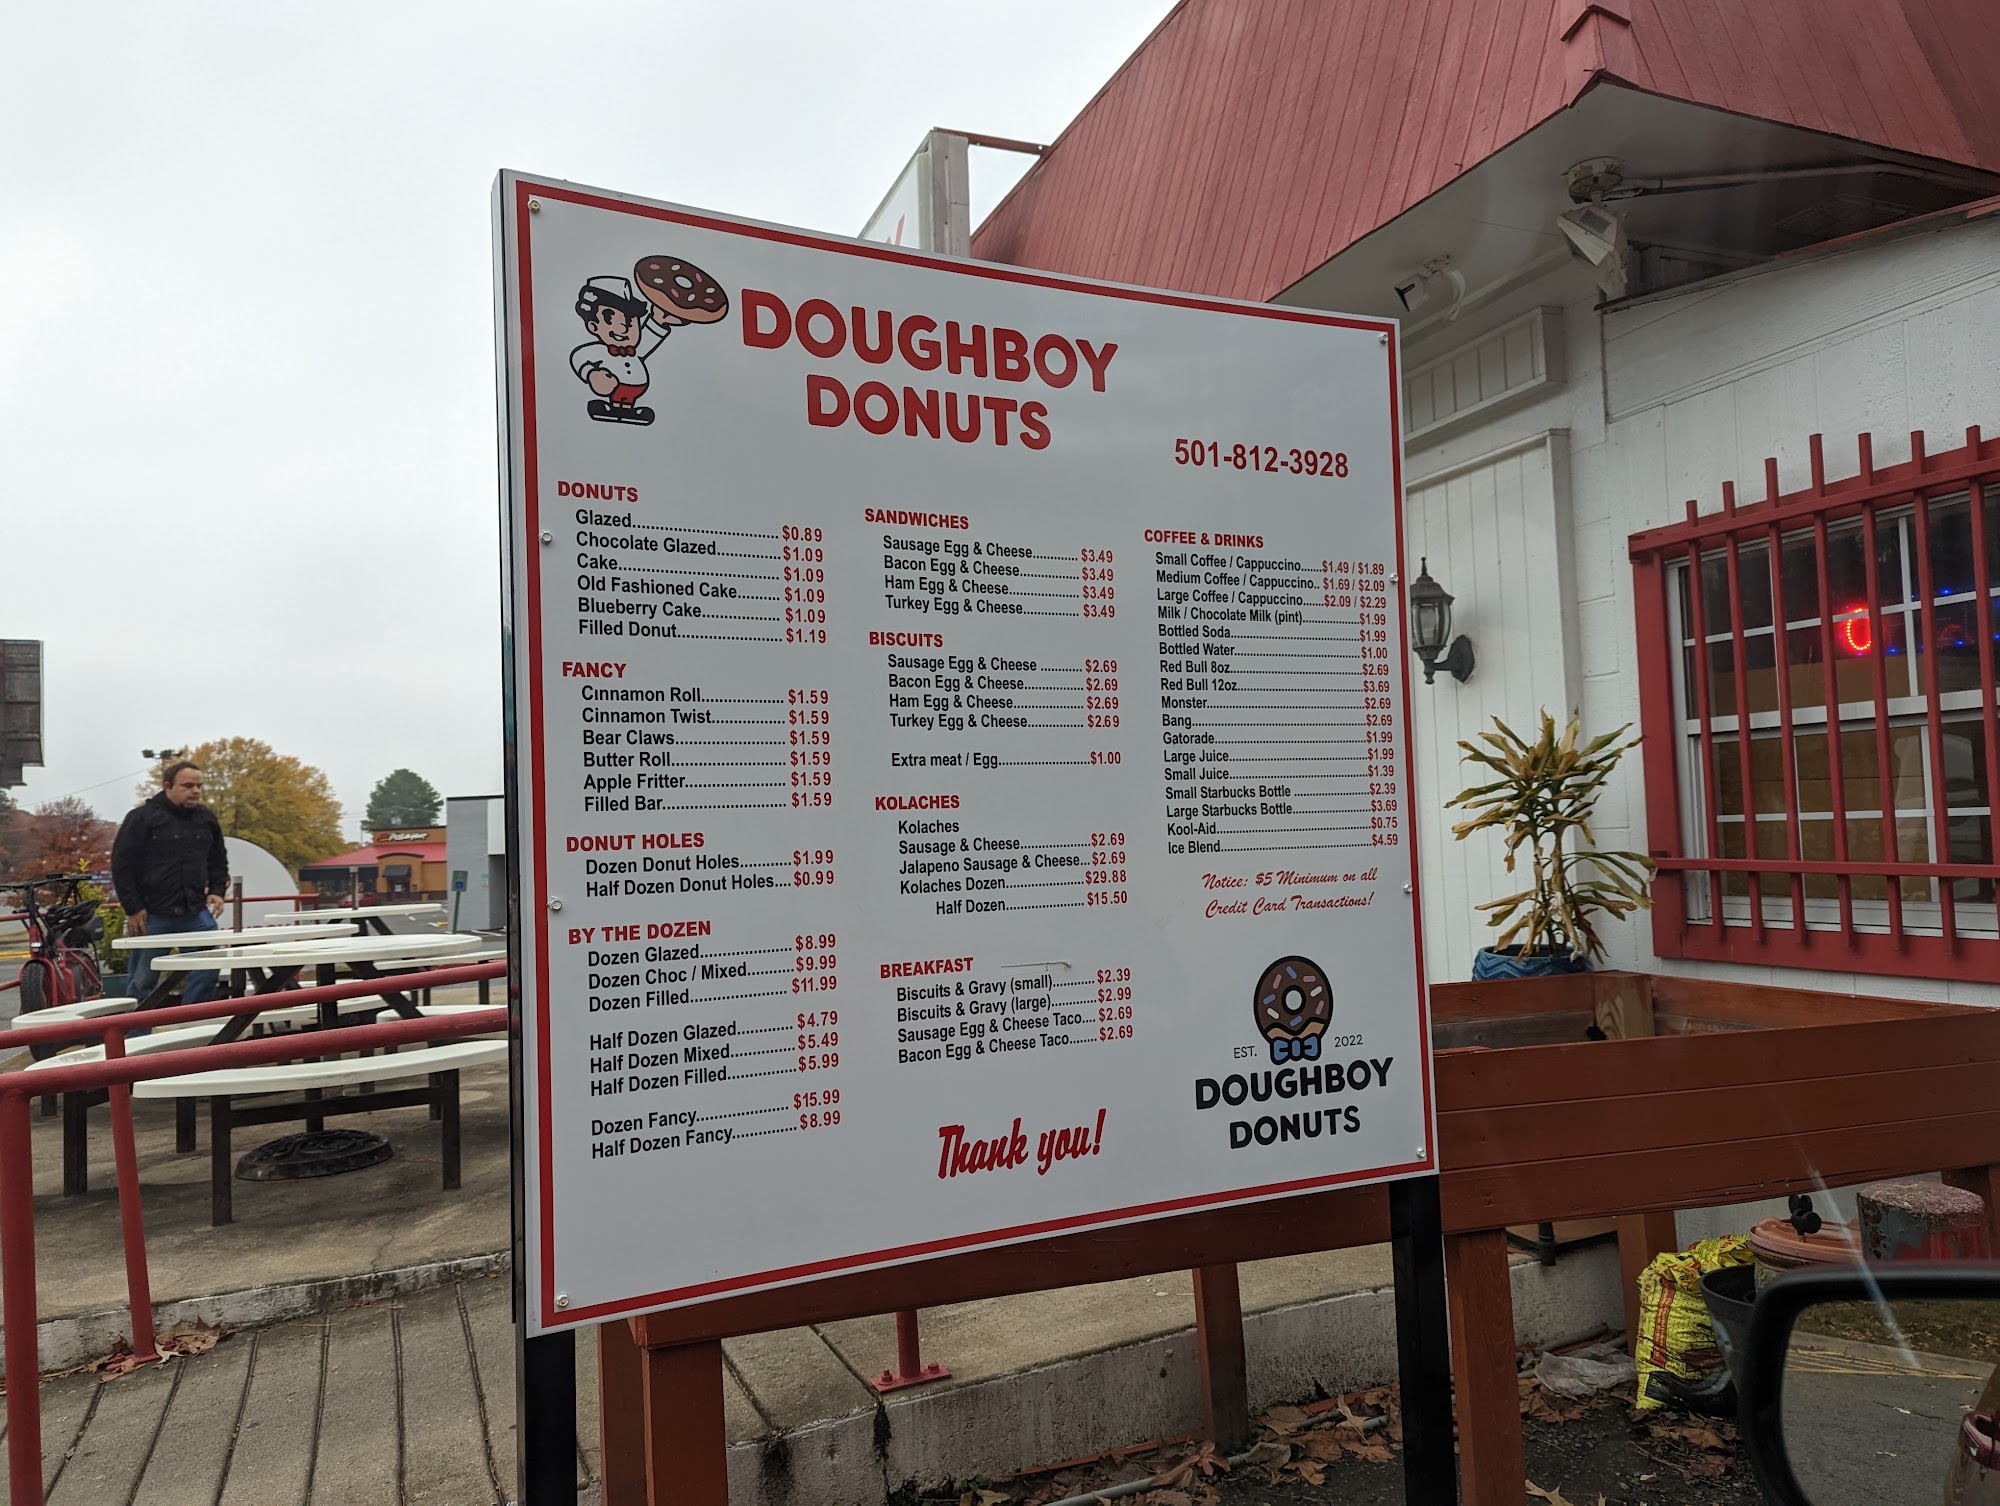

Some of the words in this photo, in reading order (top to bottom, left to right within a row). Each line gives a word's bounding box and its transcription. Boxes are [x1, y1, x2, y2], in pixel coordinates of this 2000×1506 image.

[741, 288, 1118, 393] DOUGHBOY
[806, 374, 1051, 450] DONUTS
[1174, 438, 1349, 478] 501-812-3928
[557, 480, 638, 503] DONUTS
[864, 508, 969, 530] SANDWICHES
[782, 524, 822, 543] $0.89
[1144, 529, 1196, 545] COFFEE
[1200, 532, 1210, 546] &
[1214, 533, 1264, 548] DRINKS
[576, 530, 658, 552] Chocolate
[782, 545, 823, 563] $1.09
[883, 535, 940, 555] Sausage
[944, 539, 969, 558] Egg
[973, 541, 983, 555] &
[1081, 548, 1113, 563] $3.49
[783, 565, 824, 583] $1.09
[1155, 551, 1187, 566] Small
[1190, 553, 1227, 568] Coffee
[1229, 555, 1233, 568] /
[1322, 560, 1349, 574] $1.49
[1351, 562, 1355, 574] /
[1357, 561, 1384, 575] $1.89
[577, 574, 606, 591] Old
[611, 576, 694, 596] Fashioned
[784, 586, 825, 603] $1.09
[578, 596, 658, 620] Blueberry
[785, 607, 826, 624] $1.09
[1157, 605, 1181, 619] Milk
[1183, 606, 1188, 619] /
[1190, 606, 1247, 621] Chocolate
[1249, 609, 1272, 622] Milk
[1359, 612, 1386, 626] $1.99
[579, 618, 623, 636] Filled
[786, 627, 826, 644] $1.19
[869, 631, 943, 648] BISCUITS
[1158, 623, 1199, 637] Bottled
[1359, 629, 1386, 643] $1.99
[562, 661, 627, 678] FANCY
[1159, 659, 1182, 673] Red
[1185, 660, 1207, 673] Bull
[1362, 663, 1389, 677] $2.69
[888, 673, 931, 688] Bacon
[934, 674, 960, 692] Egg
[964, 675, 974, 689] &
[1085, 677, 1118, 692] $2.69
[1364, 696, 1391, 710] $2.69
[582, 707, 665, 723] Cinnamon
[789, 709, 829, 726] $1.59
[1365, 713, 1393, 727] $2.69
[583, 729, 622, 745] Bear
[789, 729, 830, 746] $1.59
[1366, 730, 1393, 744] $1.99
[583, 751, 635, 767] Butter
[790, 750, 831, 767] $1.59
[891, 752, 927, 767] Extra
[930, 752, 963, 766] meat
[965, 752, 969, 766] /
[1090, 750, 1121, 766] $1.00
[1163, 749, 1196, 766] Large
[1367, 747, 1394, 761] $1.99
[583, 773, 632, 793] Apple
[790, 770, 831, 788] $1.59
[1165, 786, 1197, 800] Small
[1200, 785, 1256, 799] Starbucks
[1369, 782, 1396, 796] $2.39
[875, 794, 960, 811] KOLACHES
[898, 819, 960, 834] Kolaches
[1370, 816, 1398, 830] $0.75
[566, 834, 636, 852] DONUT
[642, 832, 704, 850] HOLES
[1168, 841, 1185, 854] Ice
[1371, 833, 1398, 847] $4.59
[586, 859, 637, 875] Dozen
[643, 855, 692, 872] Donut
[793, 849, 834, 867] $1.99
[899, 859, 960, 877] Jalapeno
[963, 857, 1018, 873] Sausage
[1021, 854, 1031, 868] &
[1091, 851, 1126, 867] $2.69
[586, 880, 620, 898] Half
[624, 879, 674, 895] Dozen
[680, 875, 727, 892] Donut
[793, 870, 834, 888] $0.99
[1201, 873, 1248, 890] Notice:
[1255, 871, 1274, 886] $5
[1276, 870, 1338, 885] Minimum
[1342, 873, 1357, 882] on
[1360, 867, 1378, 881] all
[936, 899, 962, 915] Half
[1087, 890, 1127, 907] $15.50
[1205, 899, 1248, 919] Credit
[1252, 896, 1287, 916] Card
[1290, 891, 1375, 911] Transactions!
[568, 927, 595, 945] BY
[601, 924, 641, 942] THE
[647, 920, 711, 939] DOZEN
[588, 950, 639, 967] Dozen
[795, 933, 836, 953] $8.99
[588, 973, 640, 990] Dozen
[645, 968, 687, 985] Choc
[691, 965, 697, 981] /
[796, 954, 836, 973] $9.99
[880, 956, 974, 979] BREAKFAST
[897, 983, 951, 1002] Biscuits
[955, 981, 965, 996] &
[968, 980, 1007, 996] Gravy
[1097, 967, 1131, 985] $2.39
[1233, 1045, 1257, 1059] EST.
[1334, 1034, 1363, 1048] 2022
[590, 1054, 624, 1074] Half
[628, 1052, 679, 1069] Dozen
[797, 1031, 838, 1052] $5.49
[1195, 1056, 1394, 1110] DOUGHBOY
[1229, 1105, 1361, 1150] DONUTS
[937, 1117, 1029, 1179] Thank
[1036, 1108, 1107, 1176] you!
